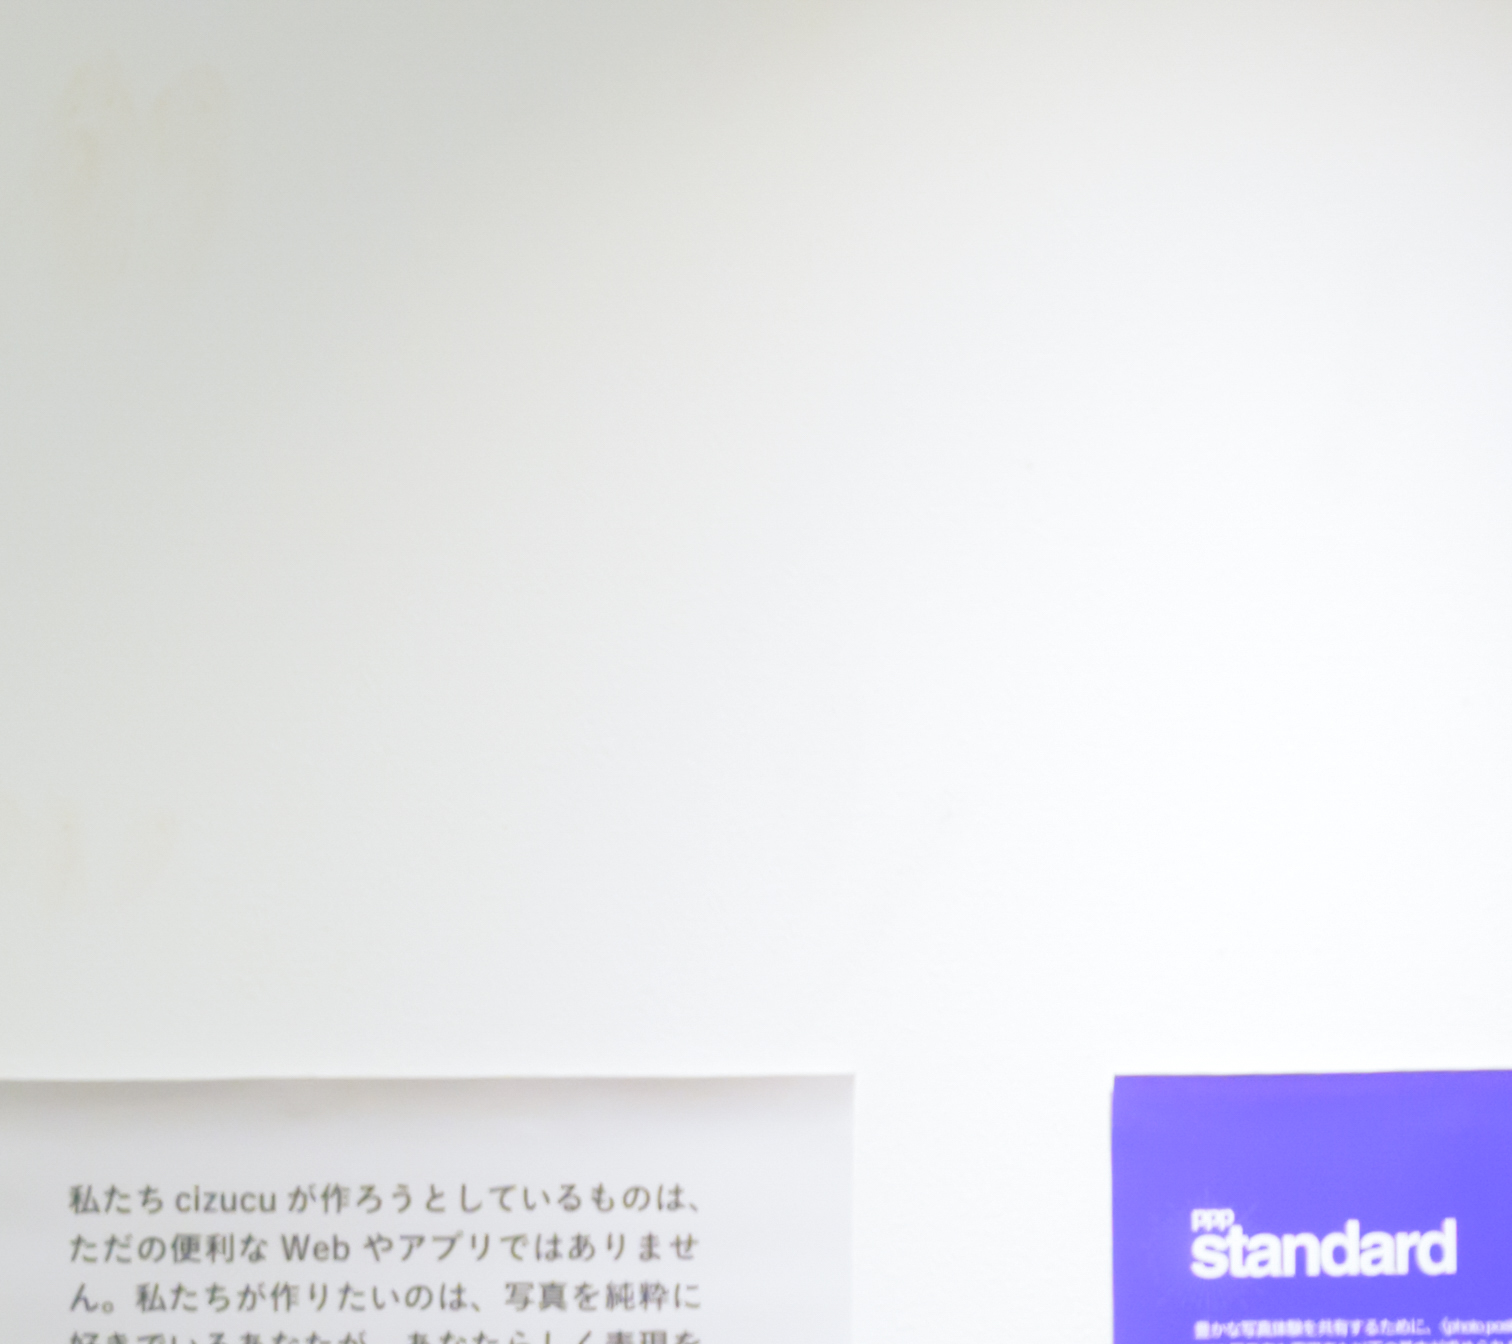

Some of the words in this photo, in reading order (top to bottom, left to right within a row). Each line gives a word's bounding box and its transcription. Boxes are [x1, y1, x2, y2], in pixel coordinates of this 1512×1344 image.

[68, 1184, 164, 1216] 私たち
[173, 1184, 277, 1215] cizucu
[286, 1181, 703, 1216] が作ろうとしているものは、
[70, 1232, 268, 1265] ただの便利な
[279, 1233, 351, 1263] Web
[362, 1230, 698, 1264] やアプリではありませ
[1191, 1217, 1458, 1279] standard
[68, 1280, 699, 1316] ん。私たちが作りたいのは、写真を純粋に
